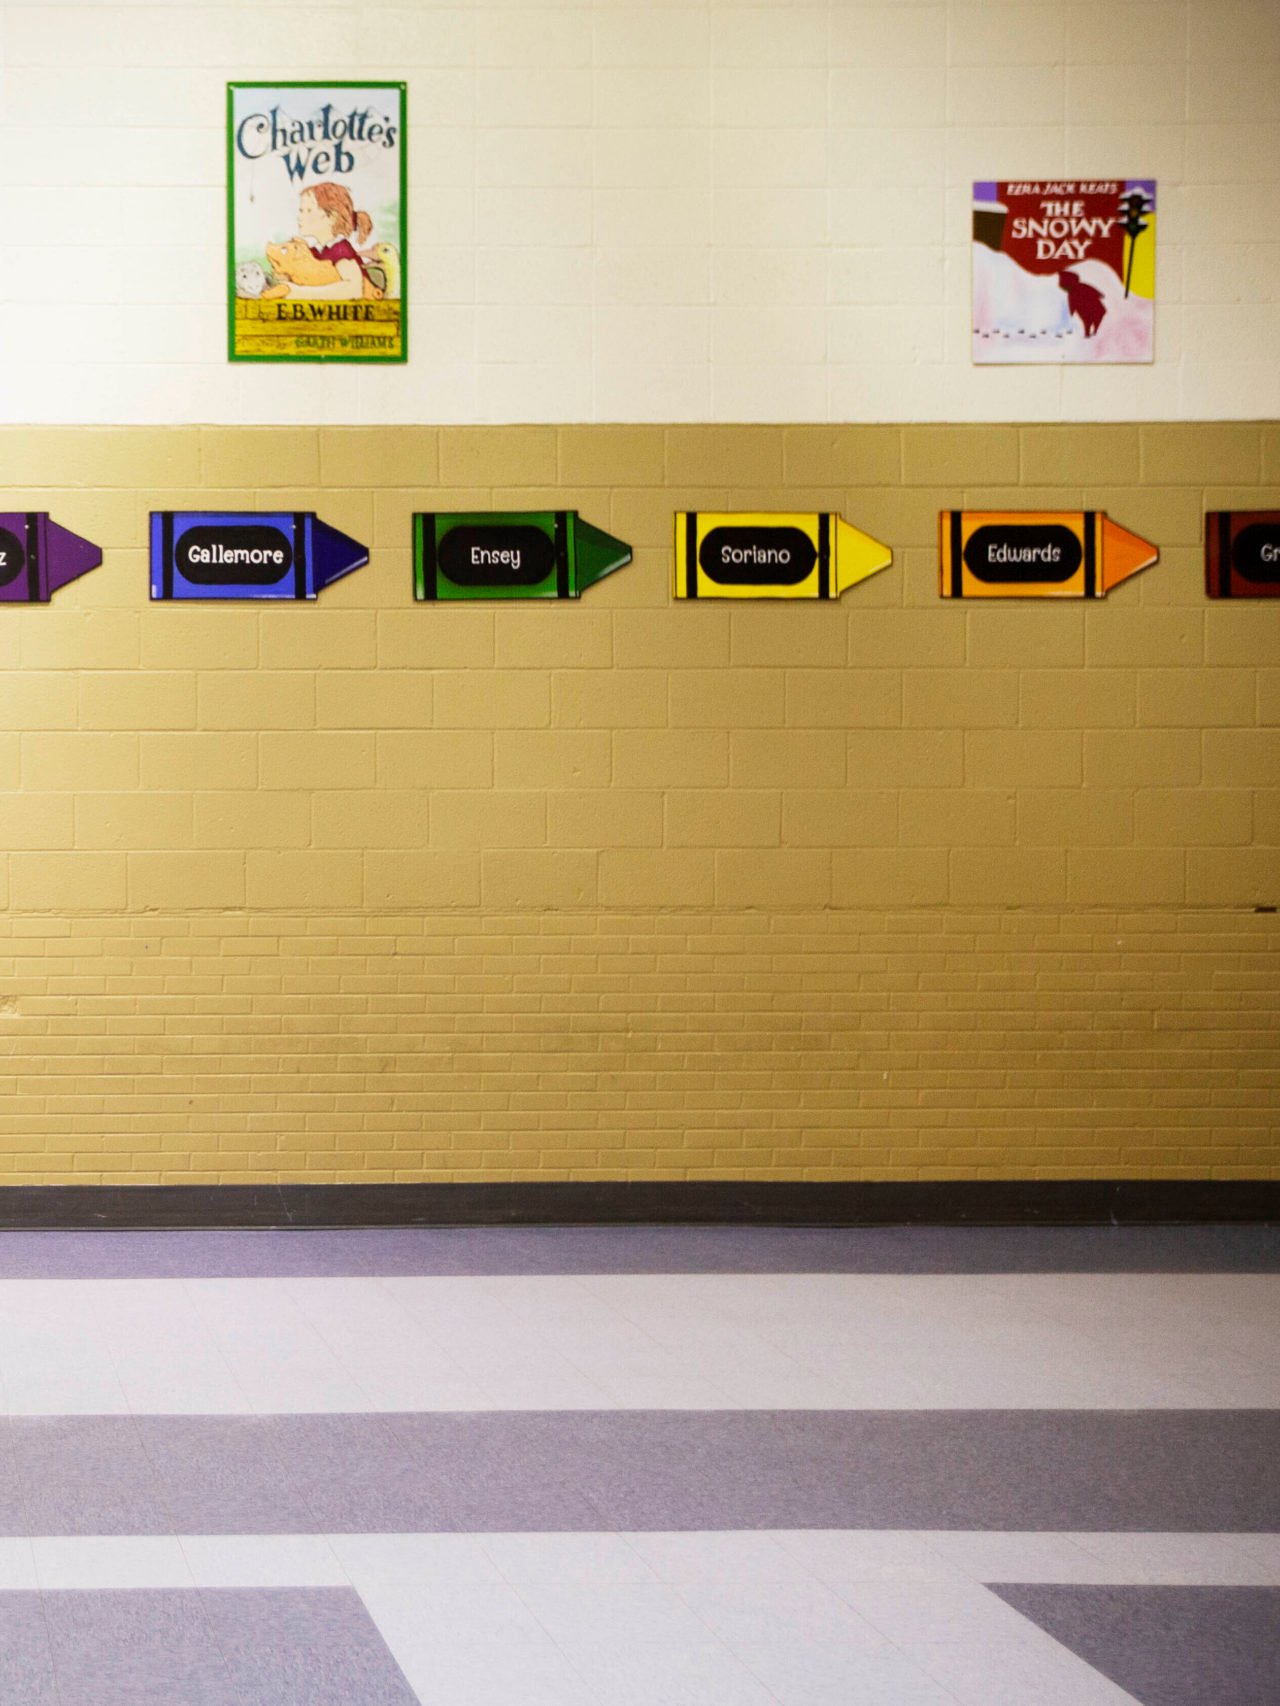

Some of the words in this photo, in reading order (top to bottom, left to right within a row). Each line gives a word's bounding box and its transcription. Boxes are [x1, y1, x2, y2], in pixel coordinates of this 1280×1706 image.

[236, 103, 398, 160] Charlotte's
[281, 142, 355, 183] Web
[1007, 183, 1040, 196] EZRA
[1041, 182, 1075, 196] JACK
[1079, 182, 1118, 194] KEATS
[1040, 200, 1084, 217] THE
[1011, 217, 1117, 238] SNOWY
[1036, 239, 1093, 260] DAY
[187, 544, 285, 565] Gallemore
[470, 546, 521, 570] Ensey
[721, 544, 791, 564] Soriano
[987, 543, 1061, 563] Edwards
